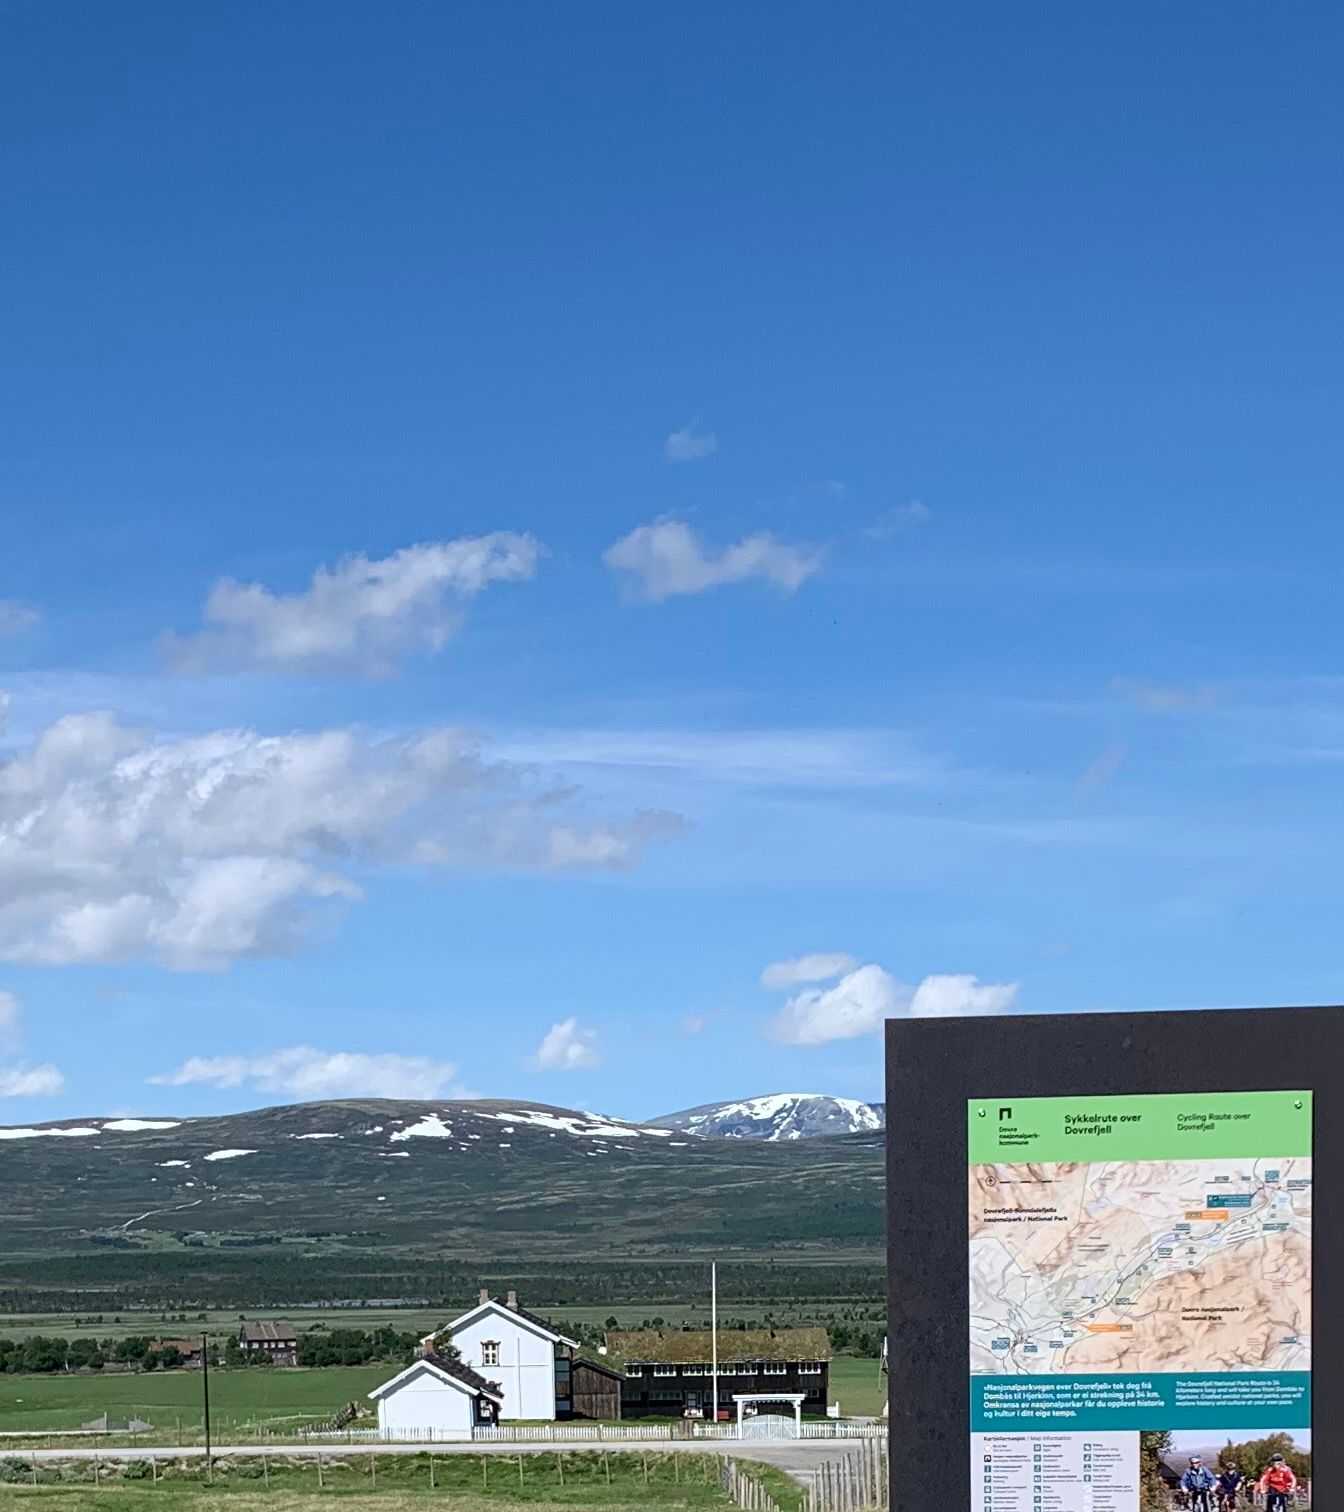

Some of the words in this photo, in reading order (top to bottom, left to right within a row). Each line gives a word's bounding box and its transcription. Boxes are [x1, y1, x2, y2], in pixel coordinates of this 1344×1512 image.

[1064, 1114, 1117, 1125] Sykkelrute
[1120, 1114, 1142, 1122] over
[1177, 1113, 1206, 1123] Cycling
[1209, 1113, 1231, 1121] Route
[1064, 1125, 1111, 1135] Dovrefjell
[1177, 1123, 1215, 1132] Dovrefjell
[984, 1392, 1012, 1400] Dombås
[1023, 1392, 1055, 1401] Hjerkinn,
[1090, 1392, 1124, 1400] strekning
[1125, 1391, 1135, 1399] på
[1108, 1400, 1135, 1408] oppleve
[1052, 1410, 1076, 1418] tempo.
